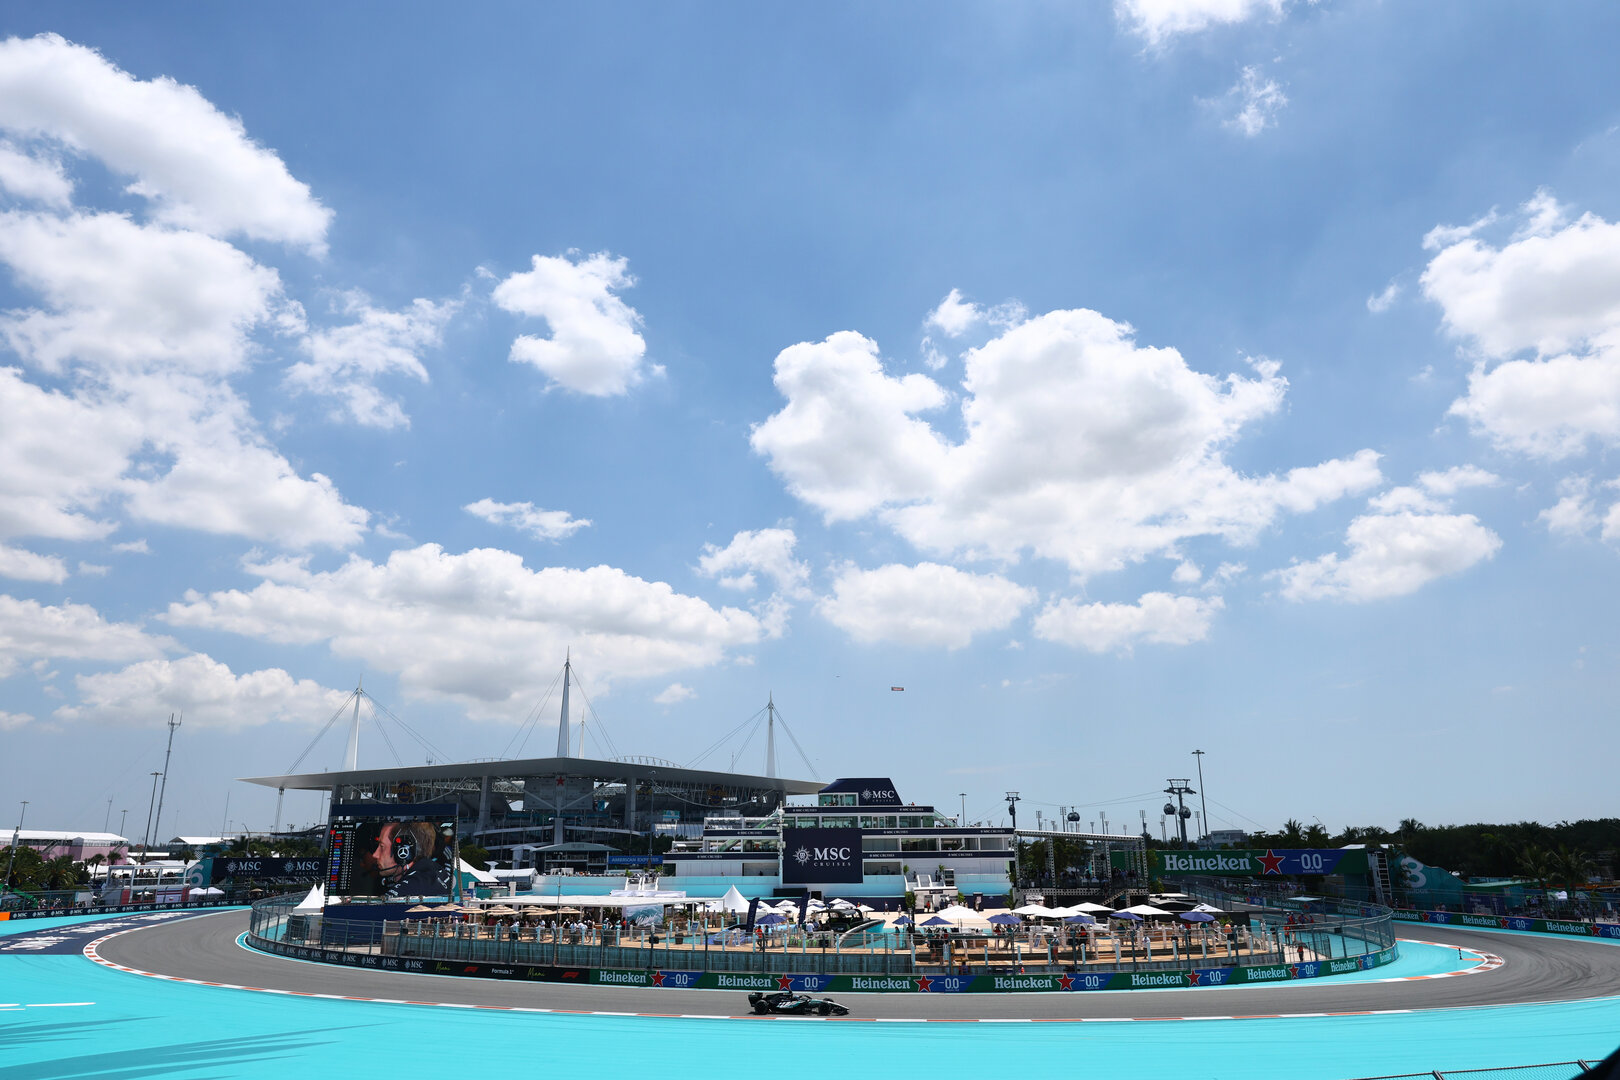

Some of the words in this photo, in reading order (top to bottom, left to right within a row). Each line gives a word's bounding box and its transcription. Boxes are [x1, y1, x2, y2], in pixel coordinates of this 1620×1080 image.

[872, 790, 894, 798] MSC
[814, 847, 850, 860] MSC
[238, 861, 261, 870] MSC
[295, 861, 319, 870] MSC
[1164, 854, 1251, 870] Heineken
[1301, 854, 1322, 869] 0.0
[189, 864, 204, 886] 6
[1462, 915, 1497, 926] Heineken
[1546, 921, 1586, 933] Heineken
[411, 960, 424, 968] MSC
[1330, 960, 1356, 972] Heineken
[600, 971, 646, 983] Heineken
[676, 973, 688, 984] 0.0
[1131, 974, 1182, 985] Heineken
[1210, 971, 1221, 982] 0.0
[1247, 967, 1287, 980] Heineken
[718, 975, 771, 987] Heineken
[804, 977, 818, 988] 0.0
[852, 977, 910, 989] Heineken
[945, 978, 959, 990] 0.0
[994, 977, 1052, 989] Heineken
[1085, 976, 1099, 987] 0.0
